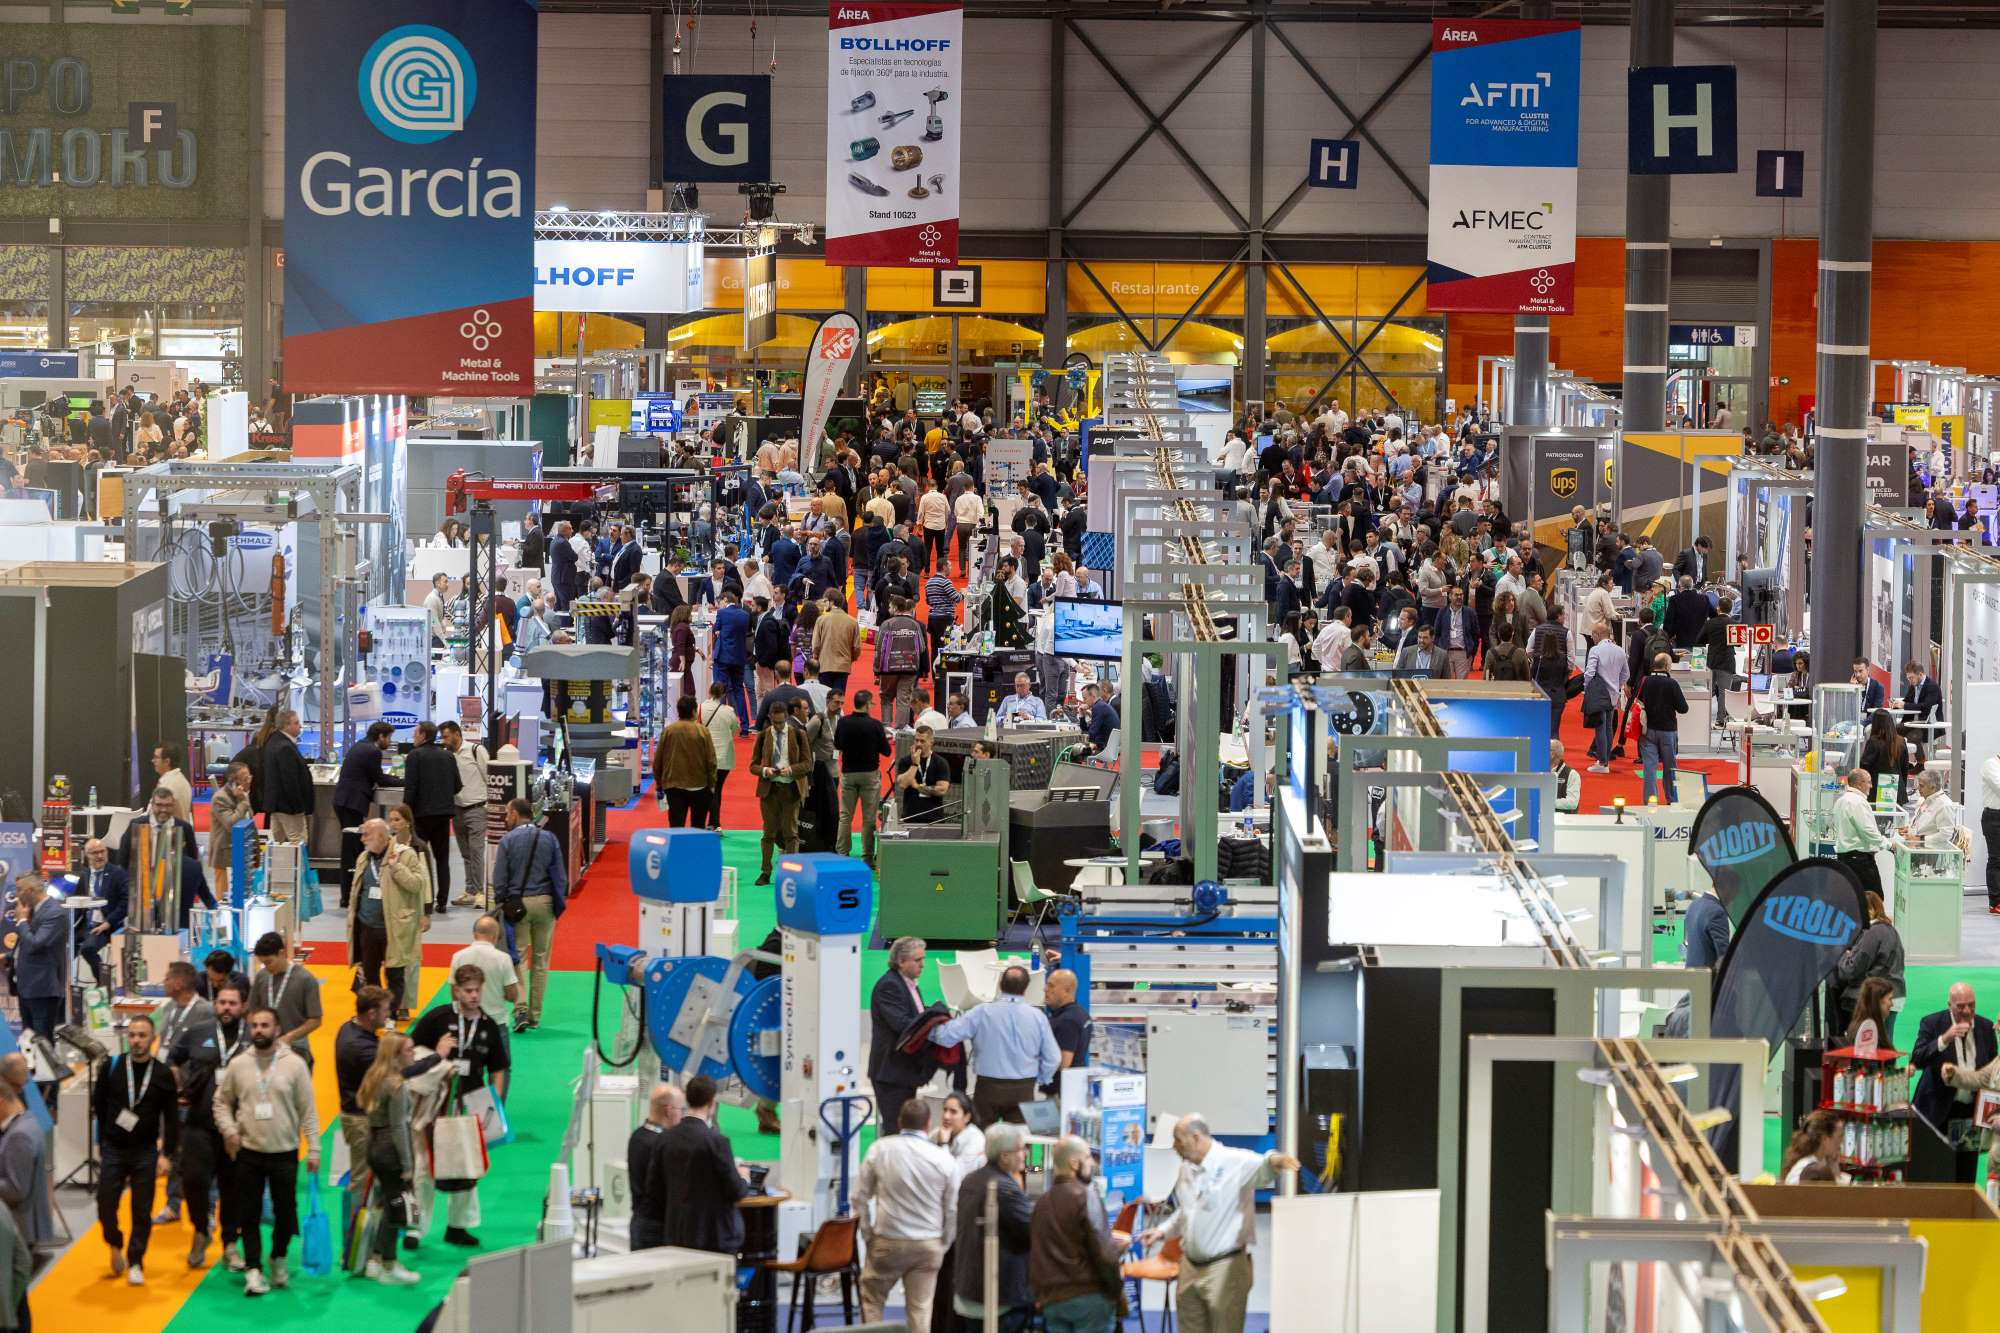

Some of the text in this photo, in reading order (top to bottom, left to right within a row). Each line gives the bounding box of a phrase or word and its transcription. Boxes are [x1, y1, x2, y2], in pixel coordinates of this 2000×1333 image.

[837, 7, 870, 20] ÁREA
[1441, 28, 1478, 41] ÁREA
[849, 57, 892, 67] Especialistas
[840, 68, 849, 76] de
[850, 68, 875, 77] fijación
[894, 70, 910, 79] para
[143, 109, 163, 143] F
[1653, 83, 1713, 158] H
[685, 91, 749, 166] G
[1320, 146, 1348, 182] H
[299, 151, 521, 219] García
[869, 210, 891, 219] Stand
[1452, 209, 1544, 230] AFMEC
[1111, 281, 1200, 296] Restaurante
[460, 358, 502, 368] Metal &
[442, 371, 520, 381] Machine Tools
[1552, 477, 1576, 494] ups
[228, 537, 273, 545] SCHMALZ
[1763, 895, 1857, 945] TYROLIT
